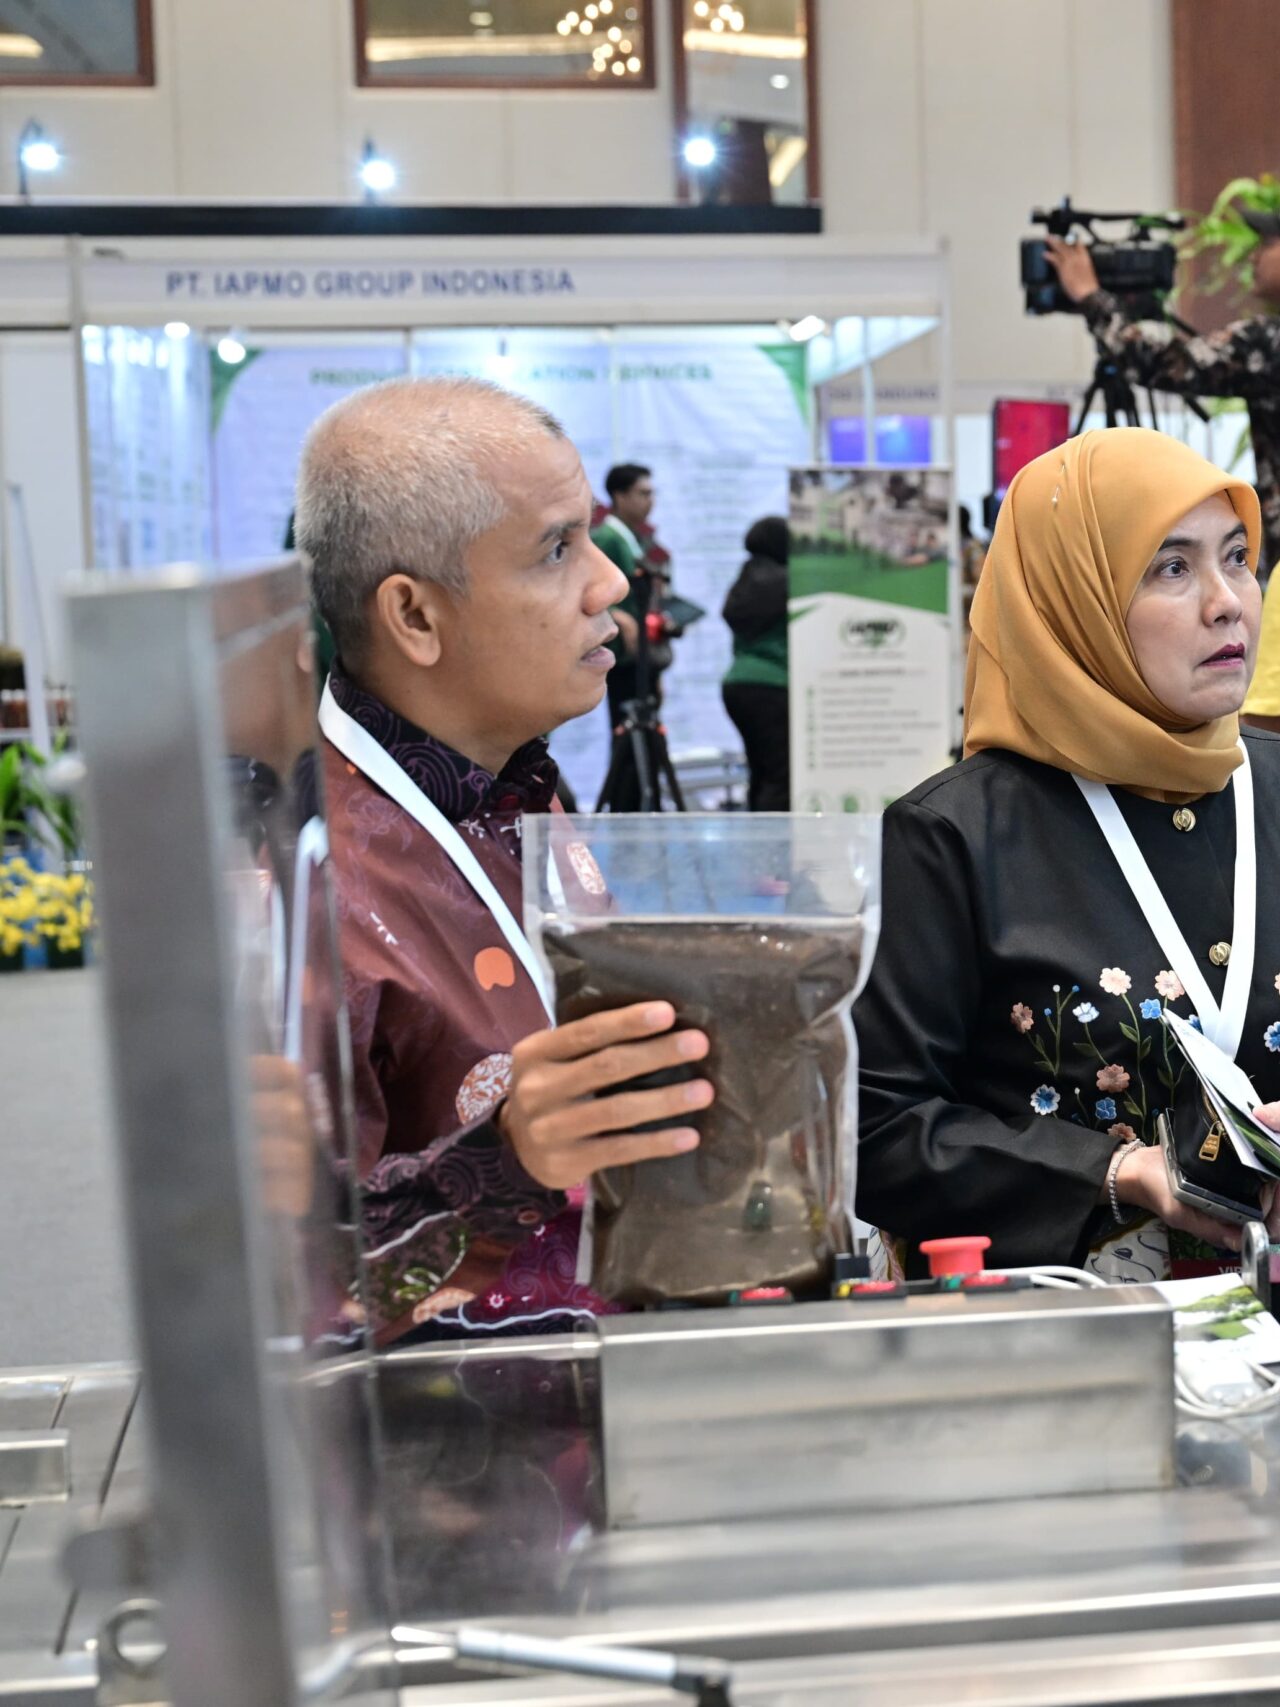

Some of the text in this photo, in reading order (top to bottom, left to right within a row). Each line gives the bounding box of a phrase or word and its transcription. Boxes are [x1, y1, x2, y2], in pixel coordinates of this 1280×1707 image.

[213, 270, 306, 296] IAPMO
[314, 269, 414, 297] GROUP
[422, 267, 577, 295] INDONESIA
